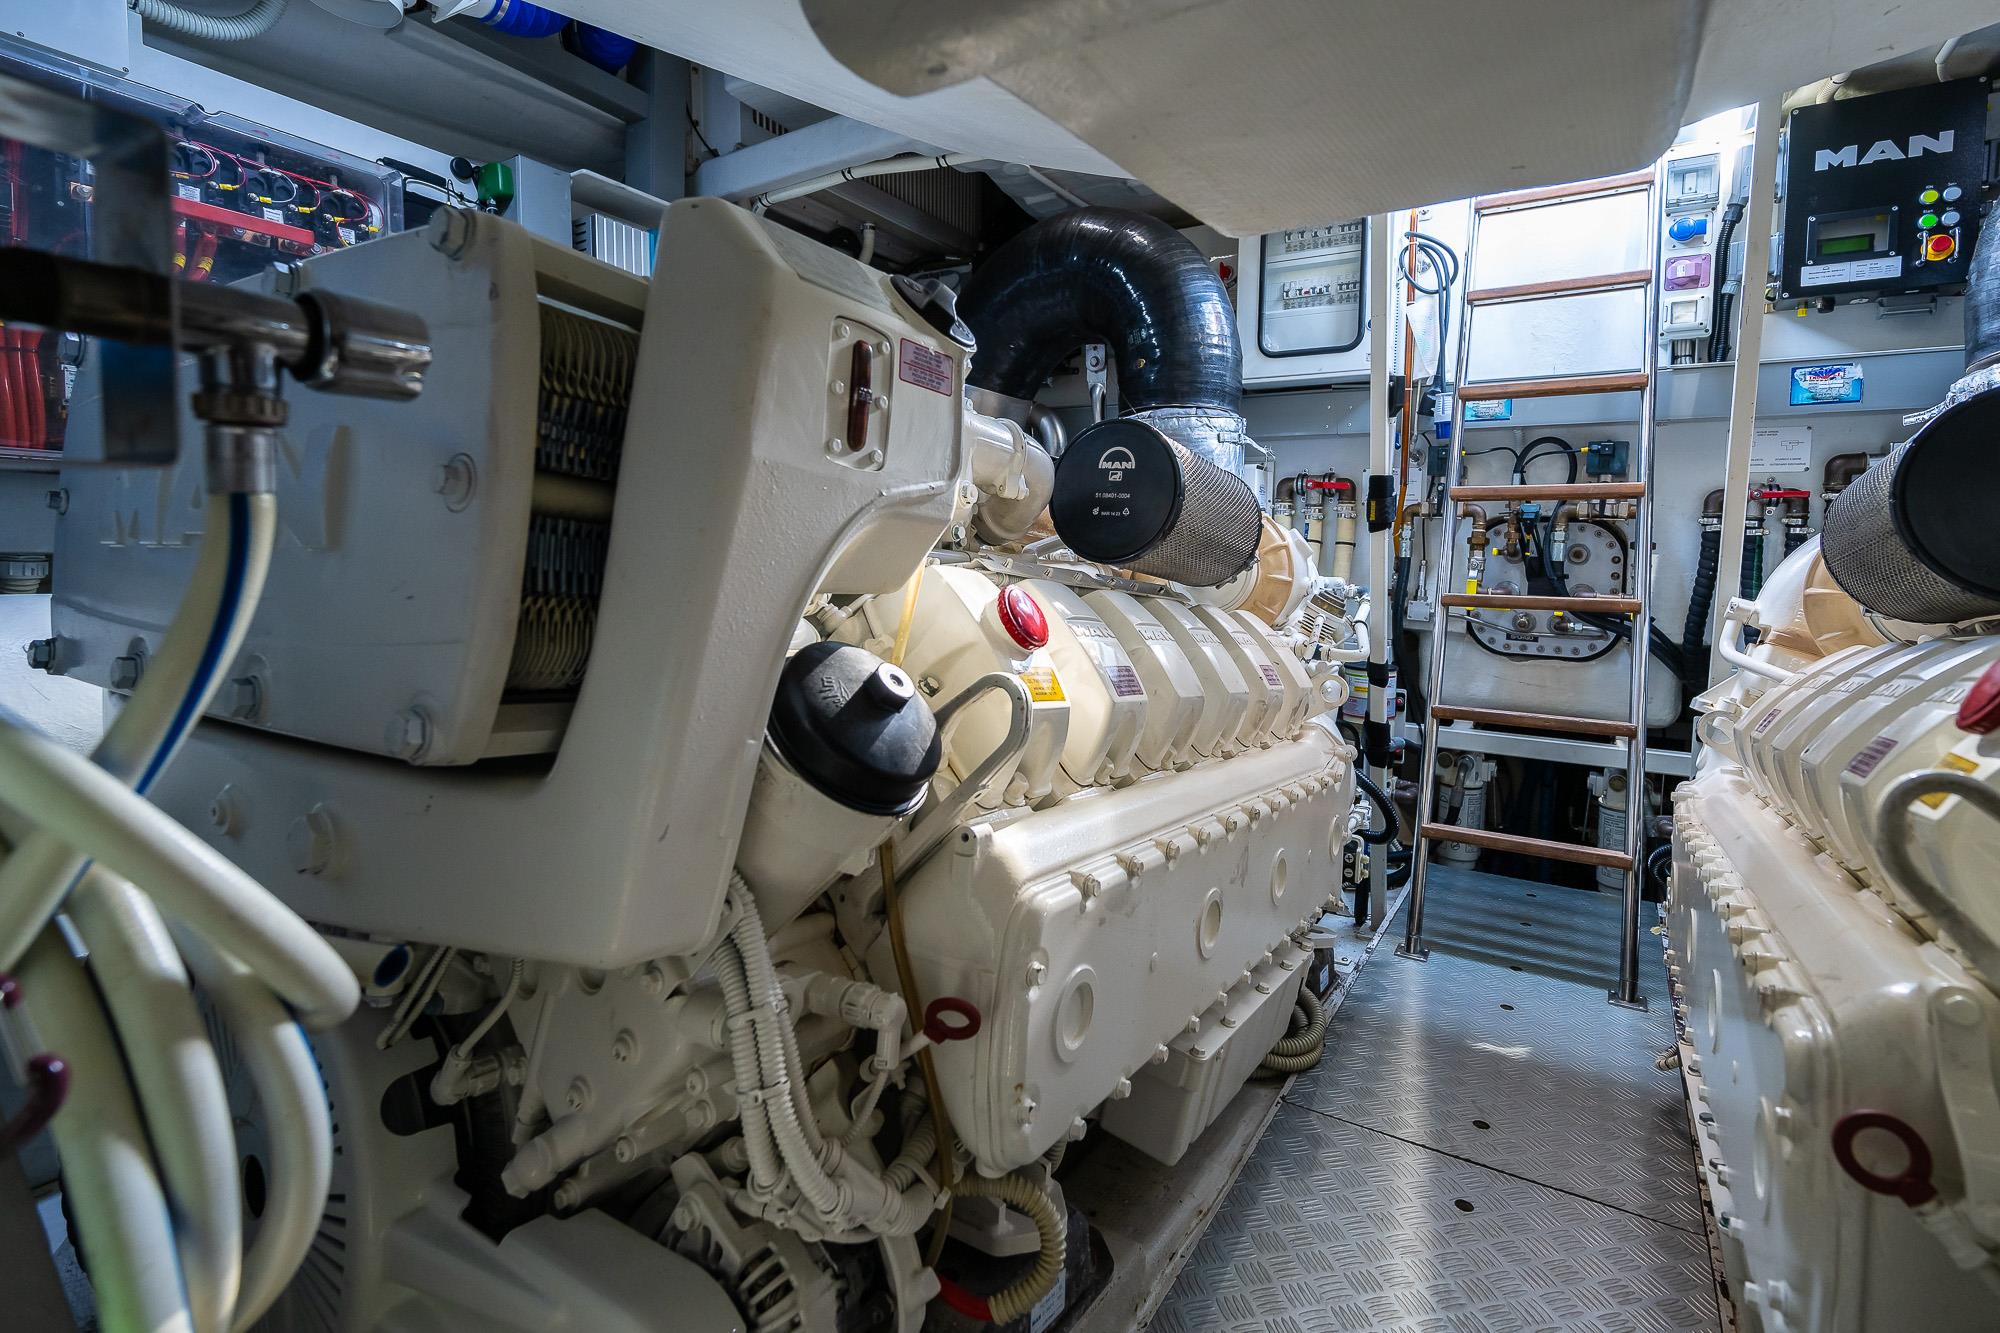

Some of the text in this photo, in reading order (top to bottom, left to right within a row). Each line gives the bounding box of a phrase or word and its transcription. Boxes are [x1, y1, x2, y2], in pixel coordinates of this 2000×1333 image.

[1814, 129, 1955, 172] MAN
[1101, 461, 1132, 469] MAN
[1071, 624, 1117, 639] MAN
[1138, 629, 1176, 642] MAN
[1192, 634, 1223, 645] MAN
